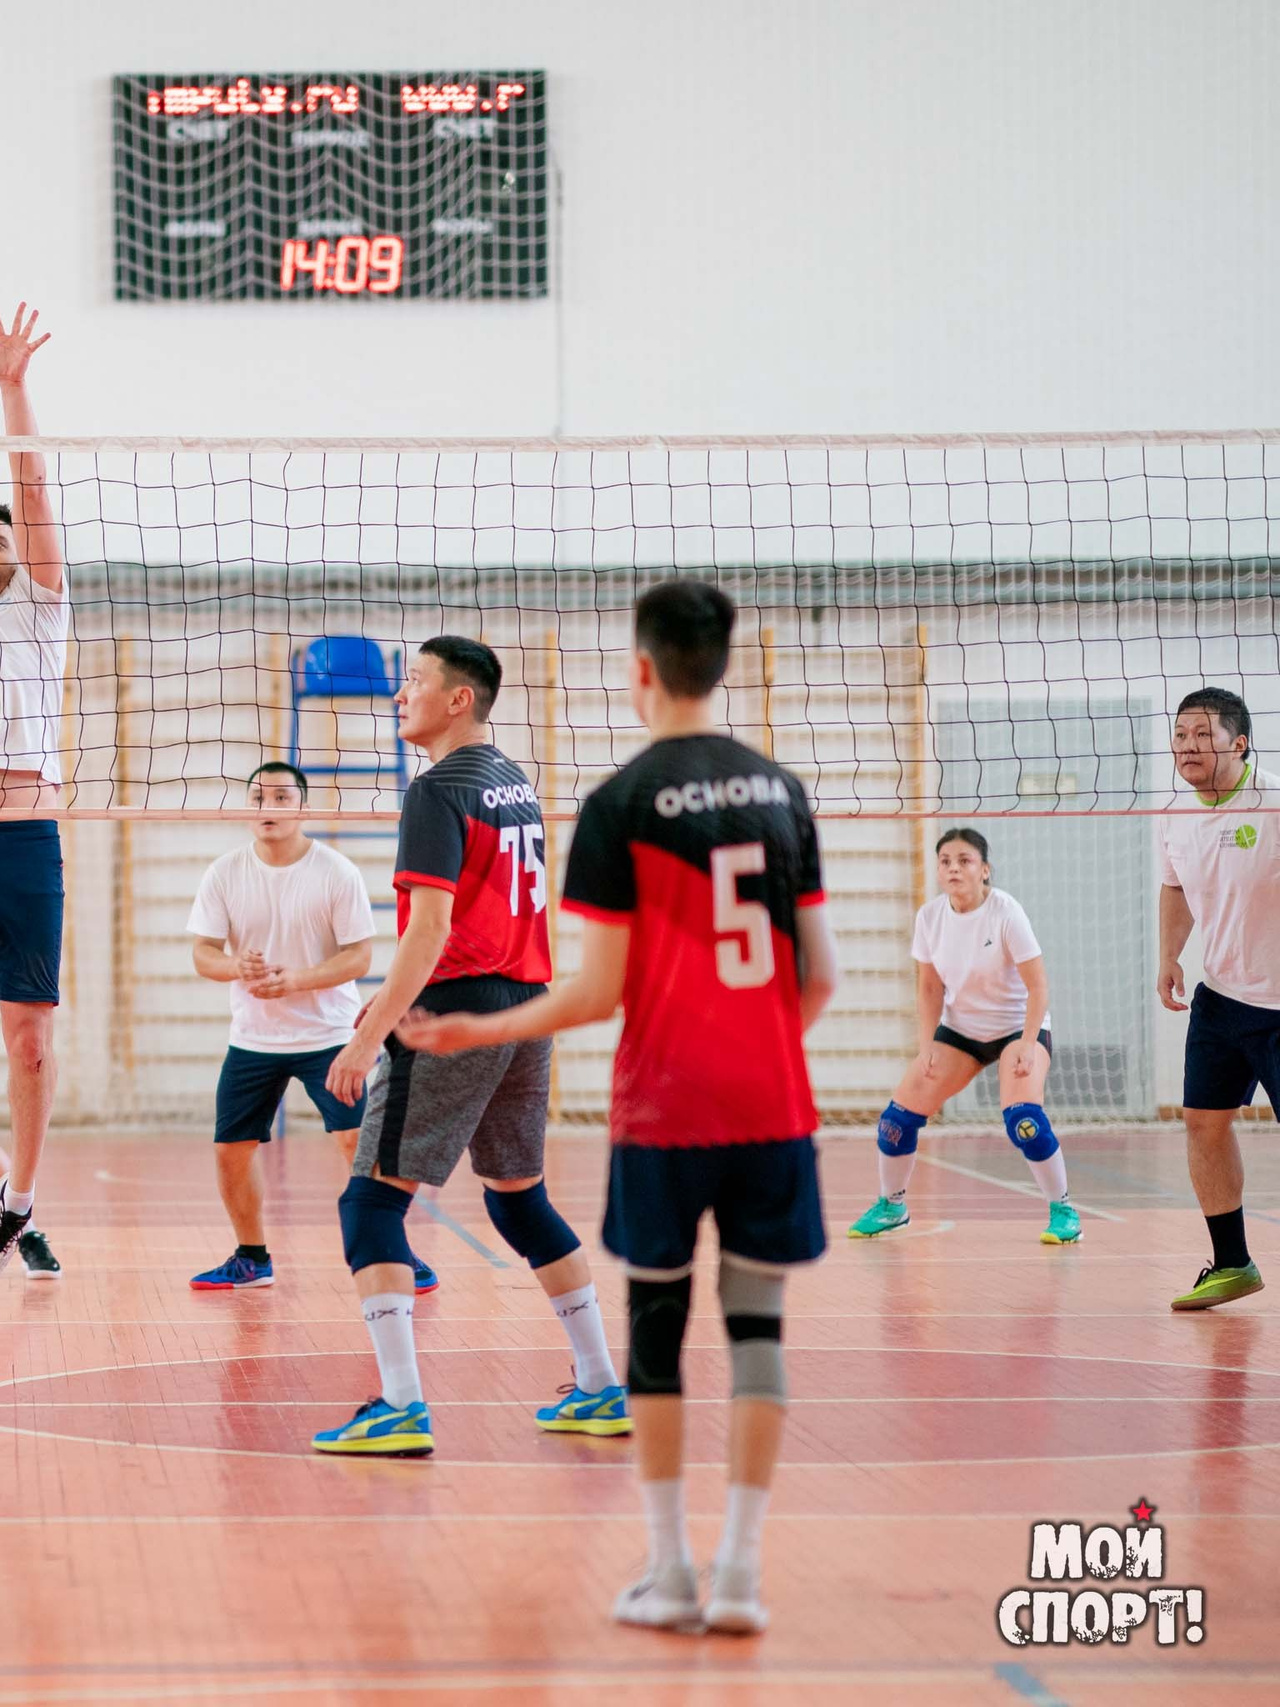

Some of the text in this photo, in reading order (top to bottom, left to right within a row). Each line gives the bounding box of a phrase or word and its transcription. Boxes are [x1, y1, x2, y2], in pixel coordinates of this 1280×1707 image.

[280, 236, 404, 292] 14:09
[654, 775, 789, 817] ОСНОВА
[499, 823, 547, 918] 75
[711, 843, 774, 989] 5
